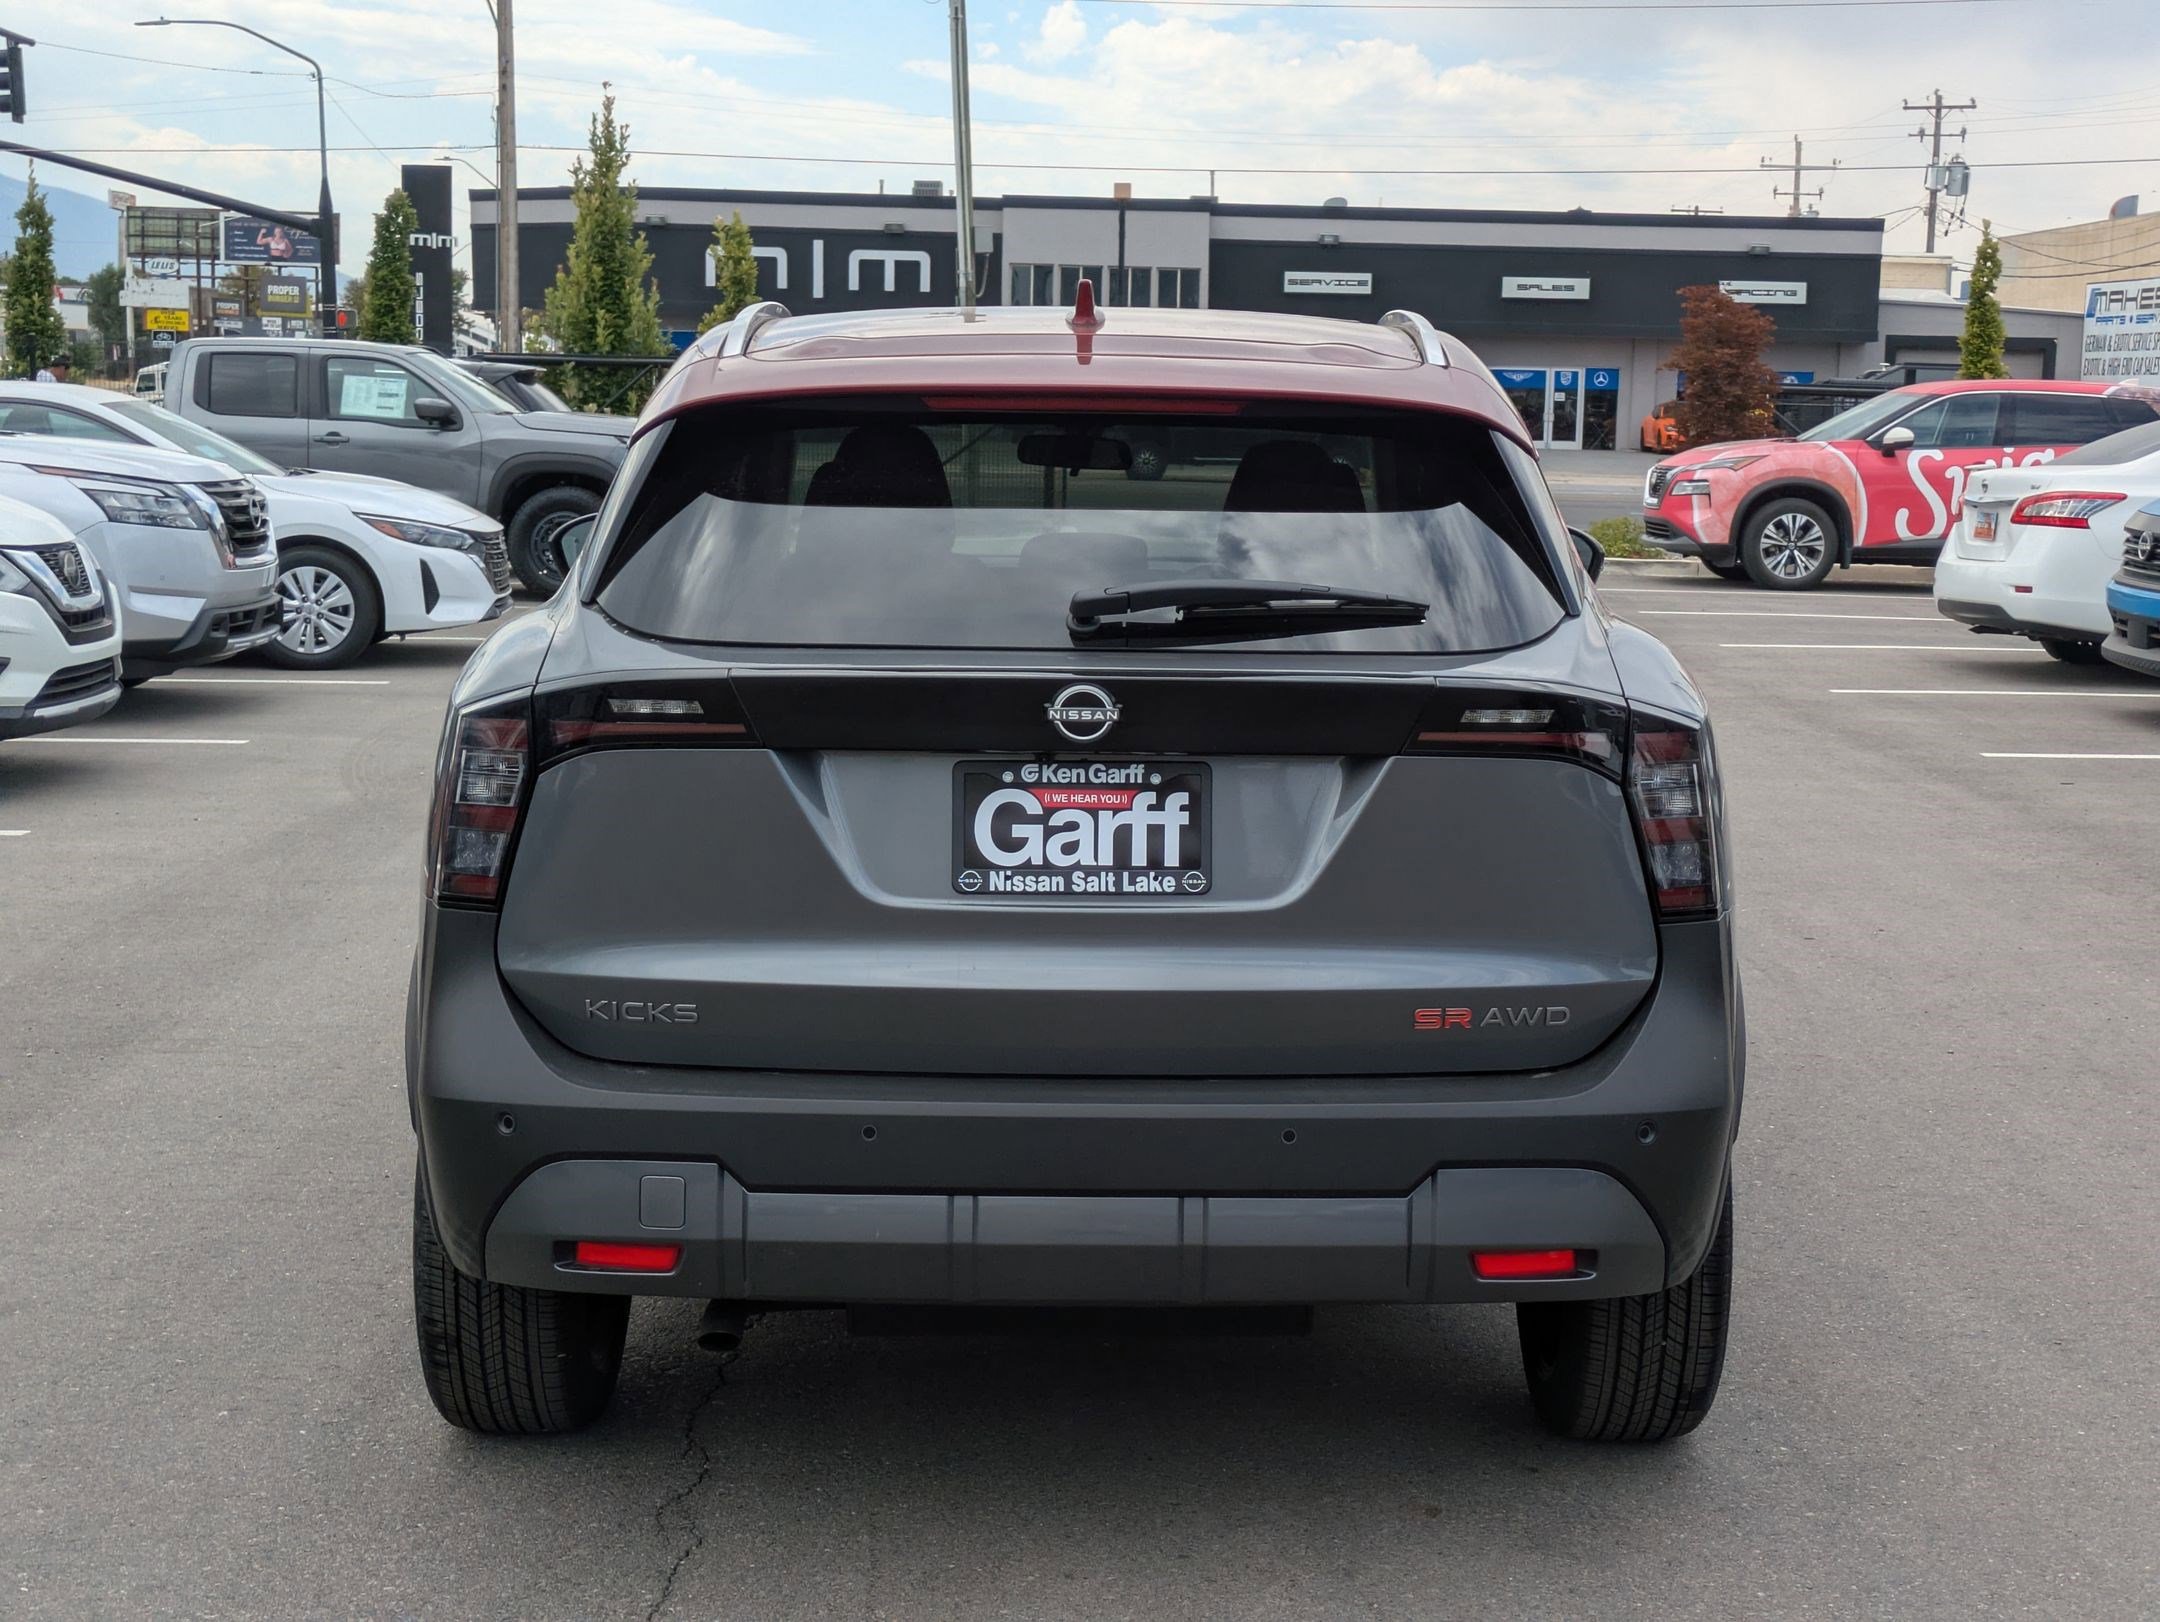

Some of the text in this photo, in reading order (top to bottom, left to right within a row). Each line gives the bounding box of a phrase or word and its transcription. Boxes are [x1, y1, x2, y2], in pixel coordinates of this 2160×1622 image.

[267, 285, 299, 295] PROPER
[1287, 278, 1369, 287] SERVICE
[1516, 283, 1575, 292] SALES
[1049, 709, 1118, 720] NISSAN
[1042, 764, 1086, 783] Ken
[1088, 764, 1145, 784] Garff
[1052, 794, 1121, 804] WE HEAR YOU
[974, 788, 1189, 867] Garff
[989, 870, 1176, 892] Nissan Salt Lake
[585, 999, 698, 1024] KICKS
[1414, 1006, 1570, 1029] SR AWD
